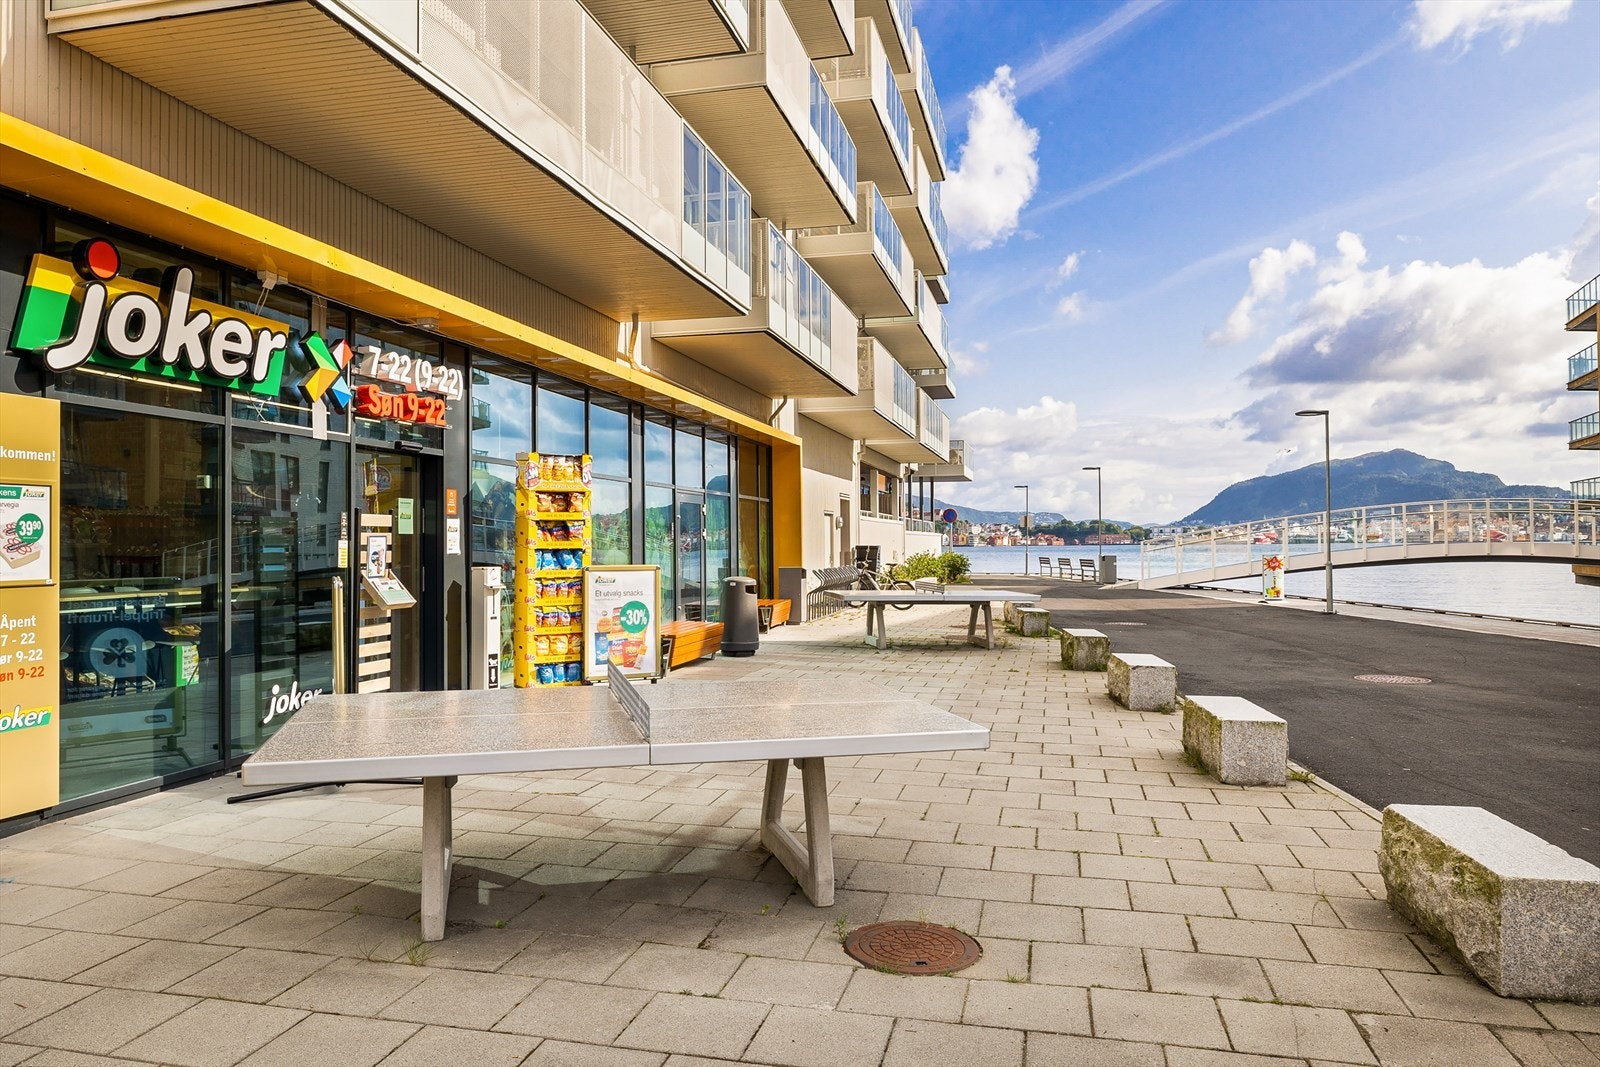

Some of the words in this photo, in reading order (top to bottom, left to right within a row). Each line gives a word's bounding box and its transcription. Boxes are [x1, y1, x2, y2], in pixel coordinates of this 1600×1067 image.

[44, 238, 287, 382] joker
[368, 345, 412, 384] 7-22
[415, 358, 463, 401] (9-22)
[368, 383, 404, 418] Søn
[407, 392, 447, 426] 9-22
[603, 590, 622, 598] utvalg
[623, 589, 644, 597] snacks
[0, 613, 37, 630] Åpent
[621, 609, 648, 626] -30%
[20, 632, 36, 645] 22
[16, 648, 43, 663] 9-22
[17, 665, 45, 680] 9-22
[0, 704, 49, 731] oker
